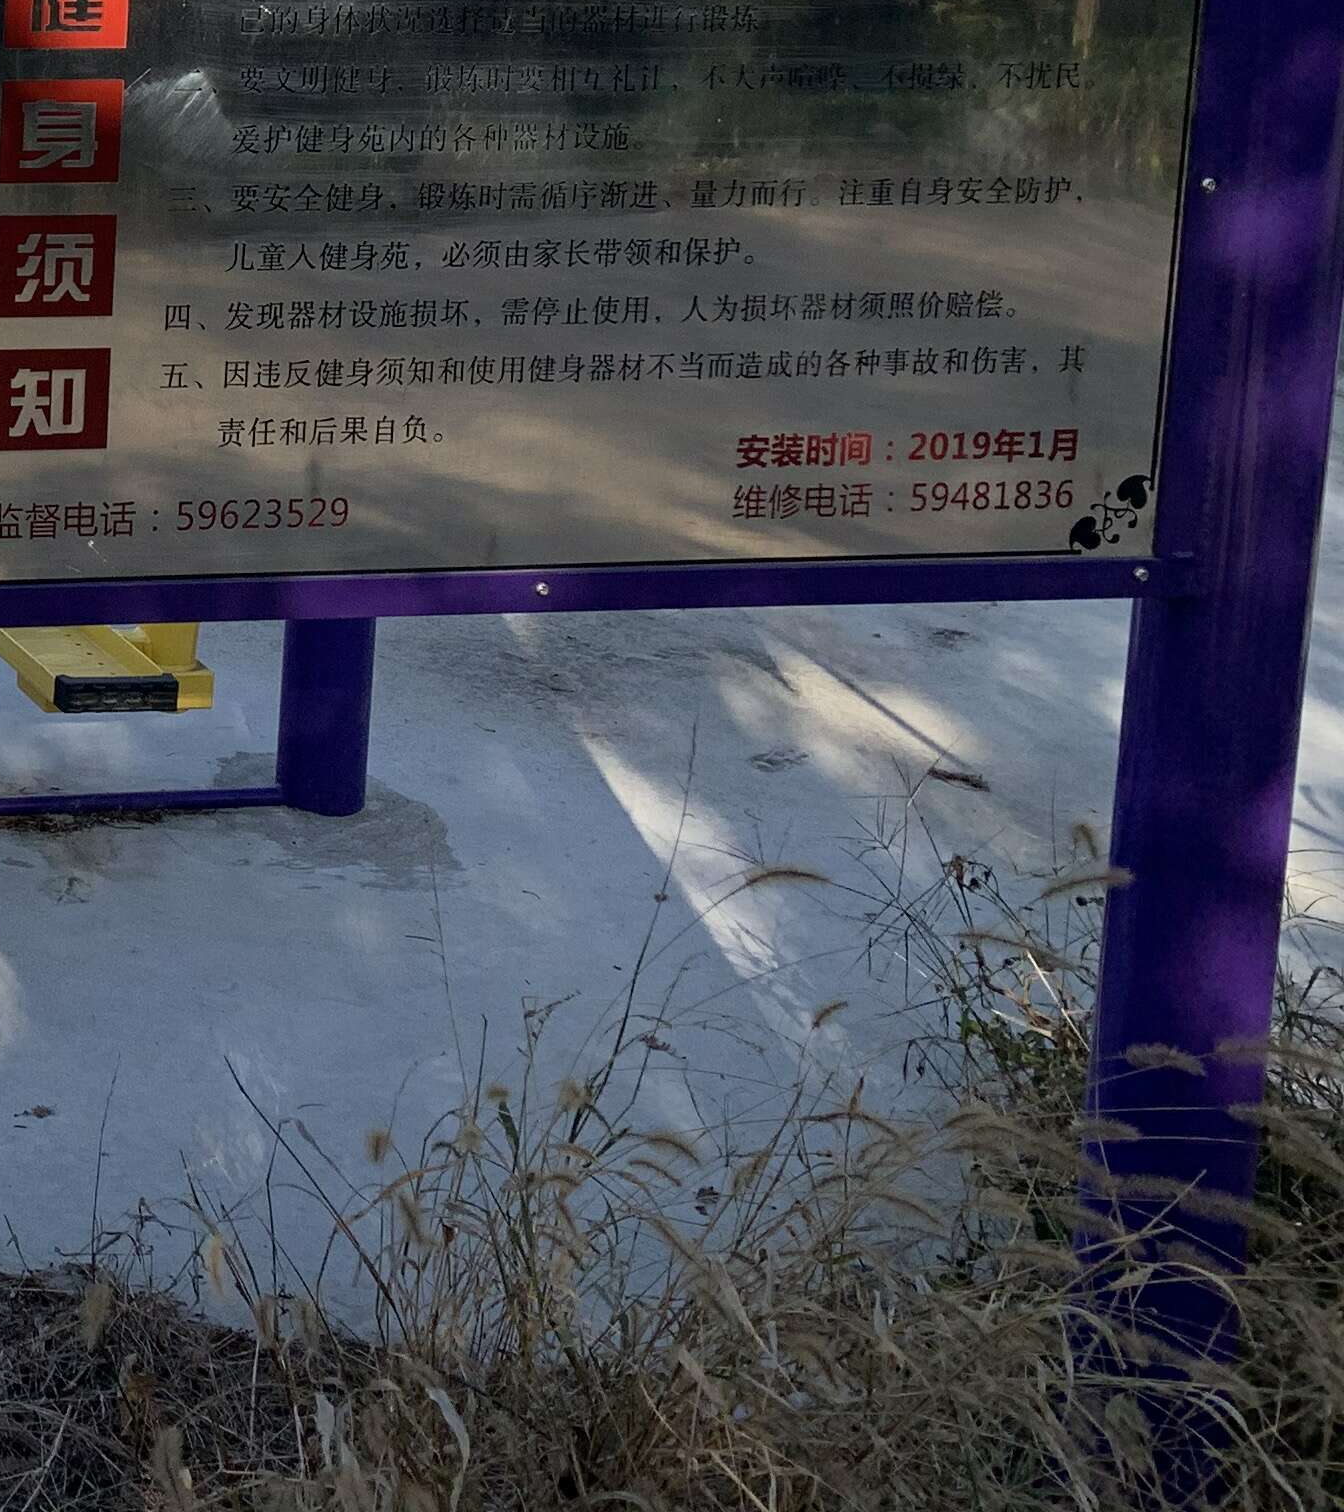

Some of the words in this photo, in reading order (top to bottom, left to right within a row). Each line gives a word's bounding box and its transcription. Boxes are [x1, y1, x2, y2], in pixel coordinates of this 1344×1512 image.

[217, 414, 449, 449] 责任和后果自负。
[735, 428, 1079, 468] 安装时间：2019年1月
[732, 480, 1074, 520] 维修电话：59481836
